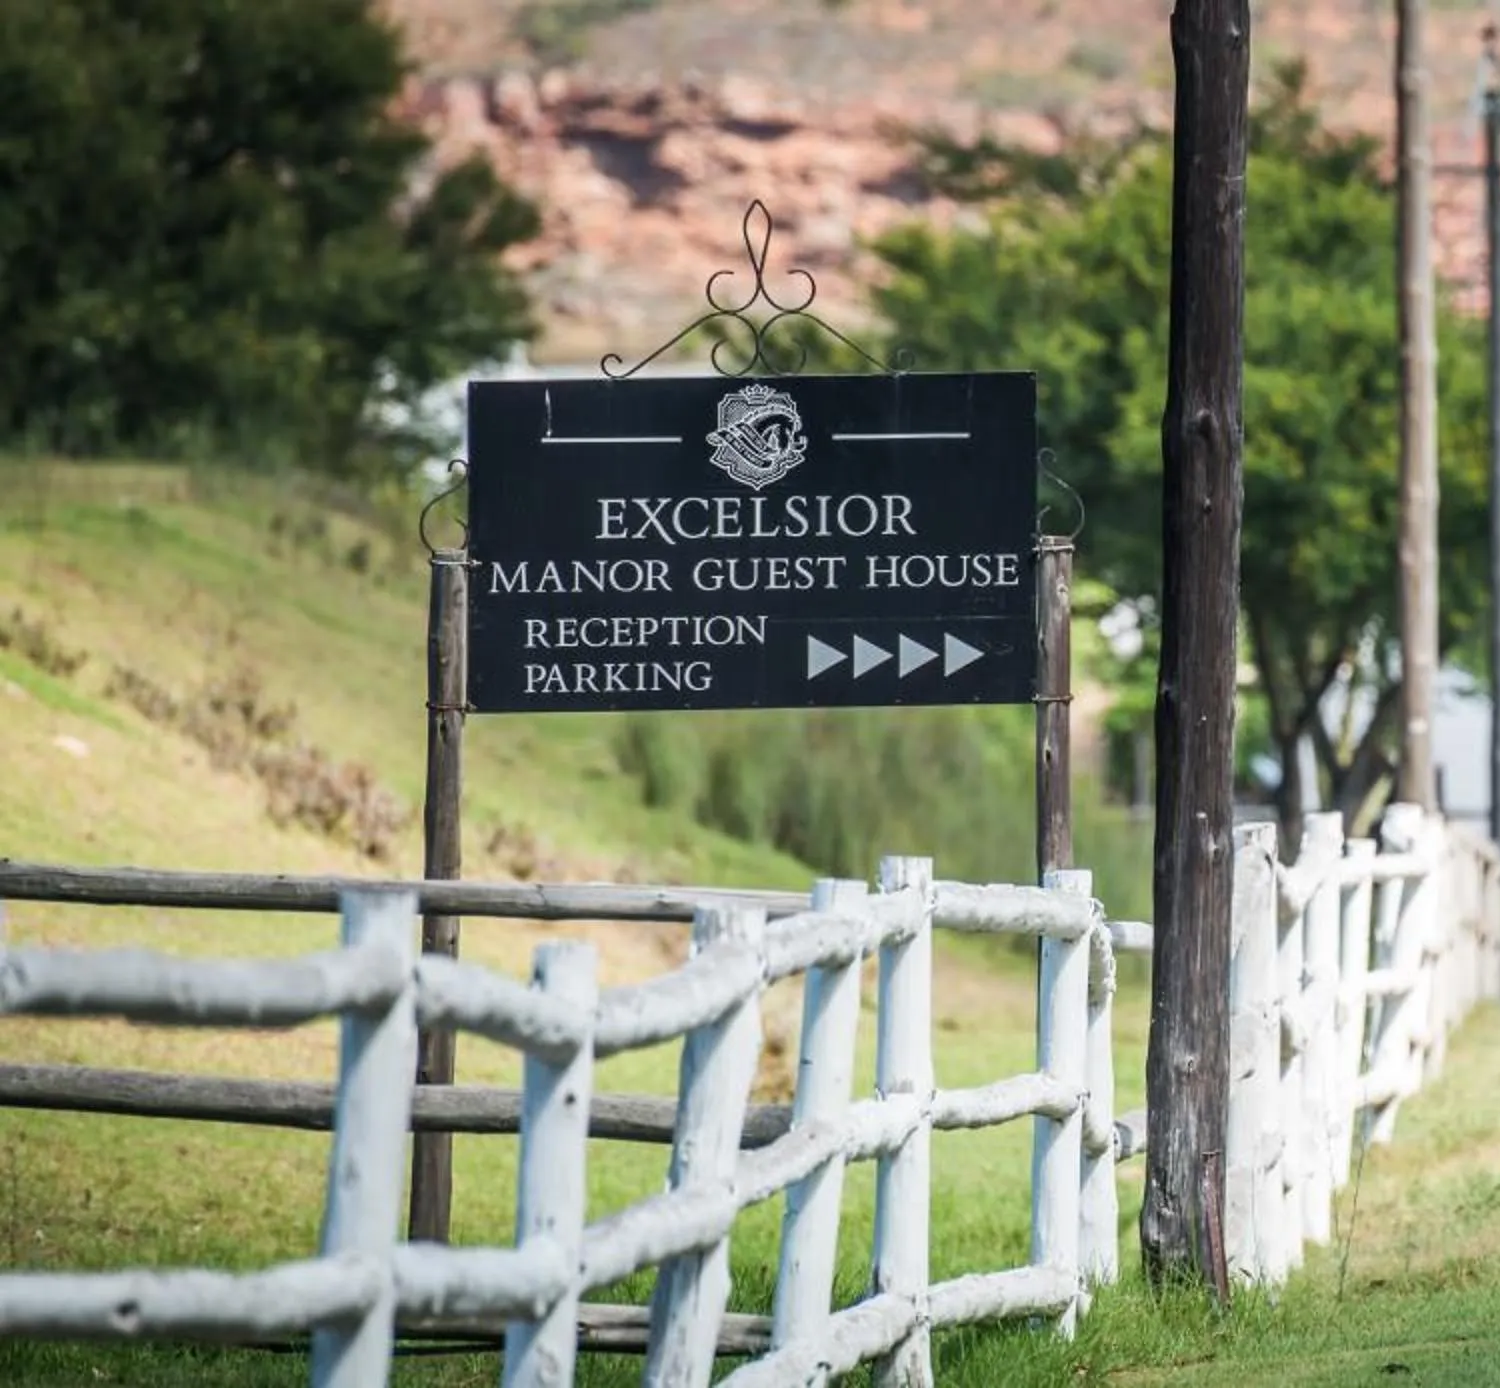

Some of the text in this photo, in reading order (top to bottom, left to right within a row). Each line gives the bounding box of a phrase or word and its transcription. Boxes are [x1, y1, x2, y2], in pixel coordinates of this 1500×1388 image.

[595, 495, 916, 545] EXCELSIOR
[489, 553, 1020, 594] MANOR GUEST HOUSE
[524, 614, 768, 649] RECEPTION
[524, 661, 713, 694] PARKING
